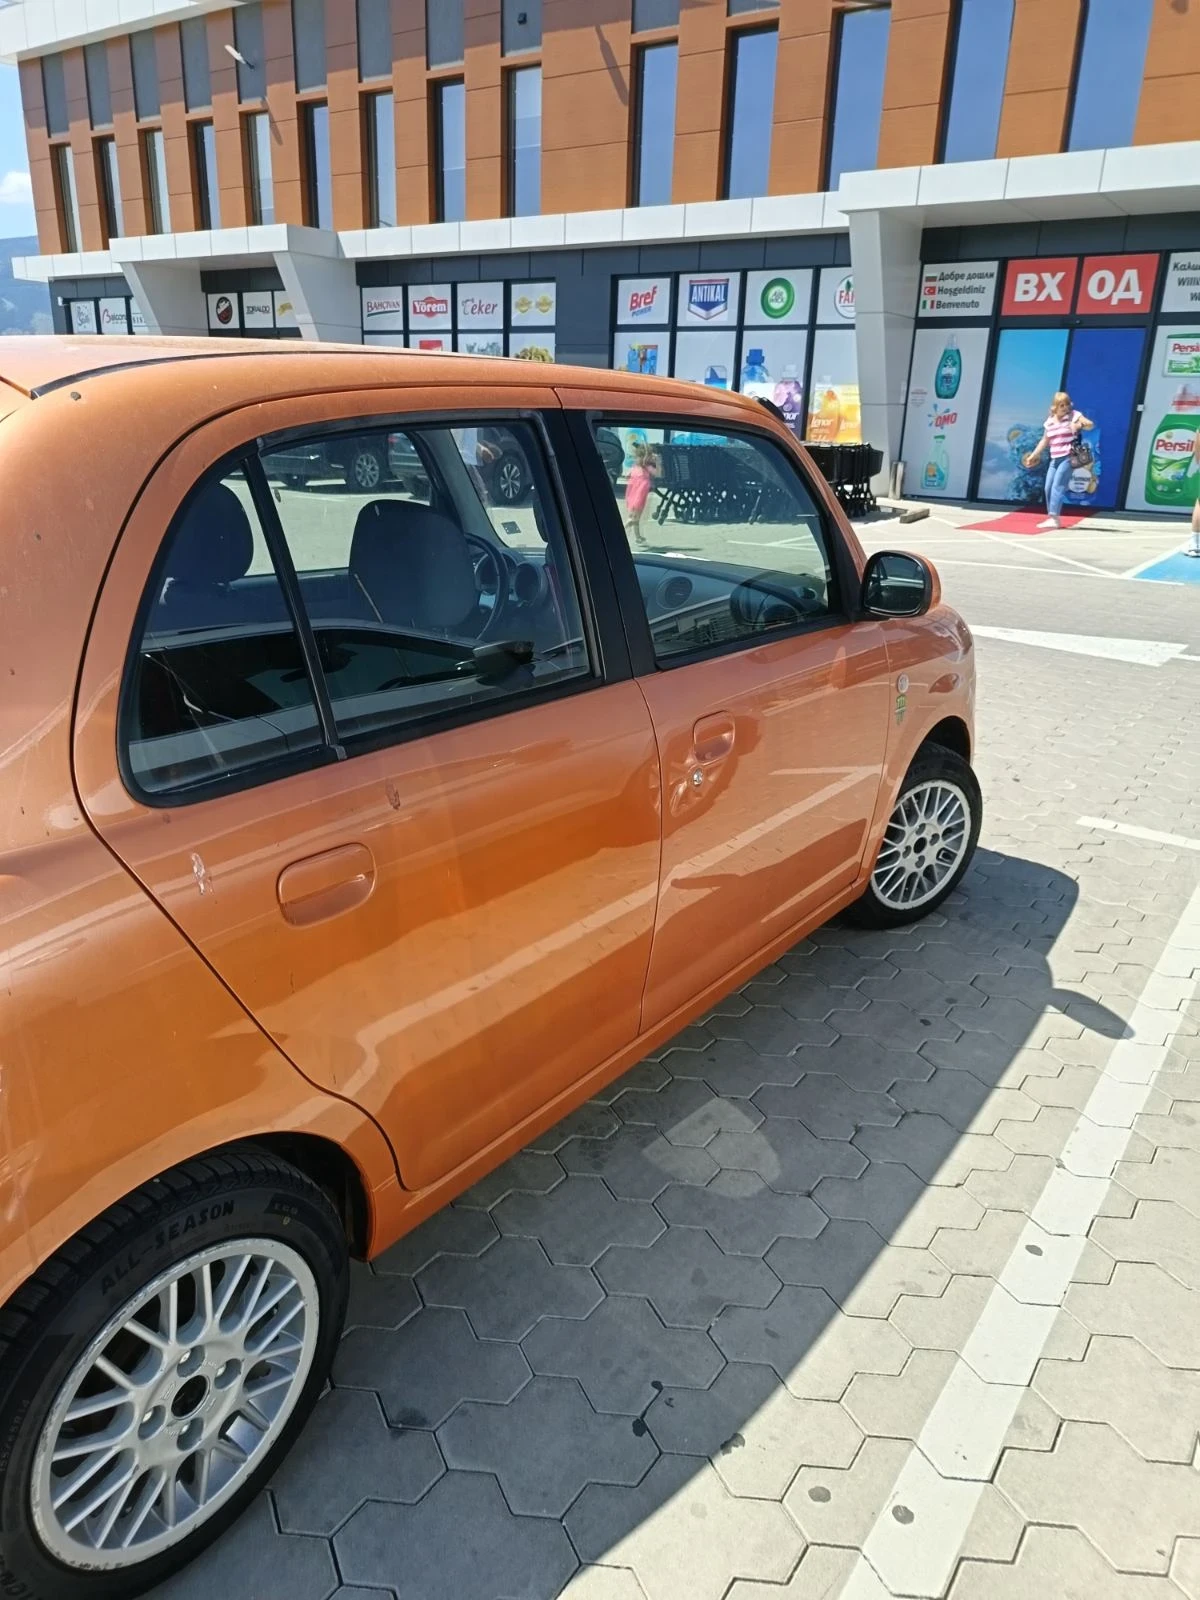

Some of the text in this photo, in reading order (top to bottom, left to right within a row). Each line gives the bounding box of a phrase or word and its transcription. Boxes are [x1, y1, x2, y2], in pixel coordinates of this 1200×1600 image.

[939, 271, 995, 282] Добре дошли
[691, 284, 725, 303] ANTIKAL
[938, 285, 986, 296] Hoşgeldiniz
[1014, 269, 1143, 305] ВХ ОД
[630, 285, 657, 311] Bref
[936, 300, 980, 309] Benvenuto
[935, 412, 958, 427] OMO
[1155, 439, 1194, 452] Persil
